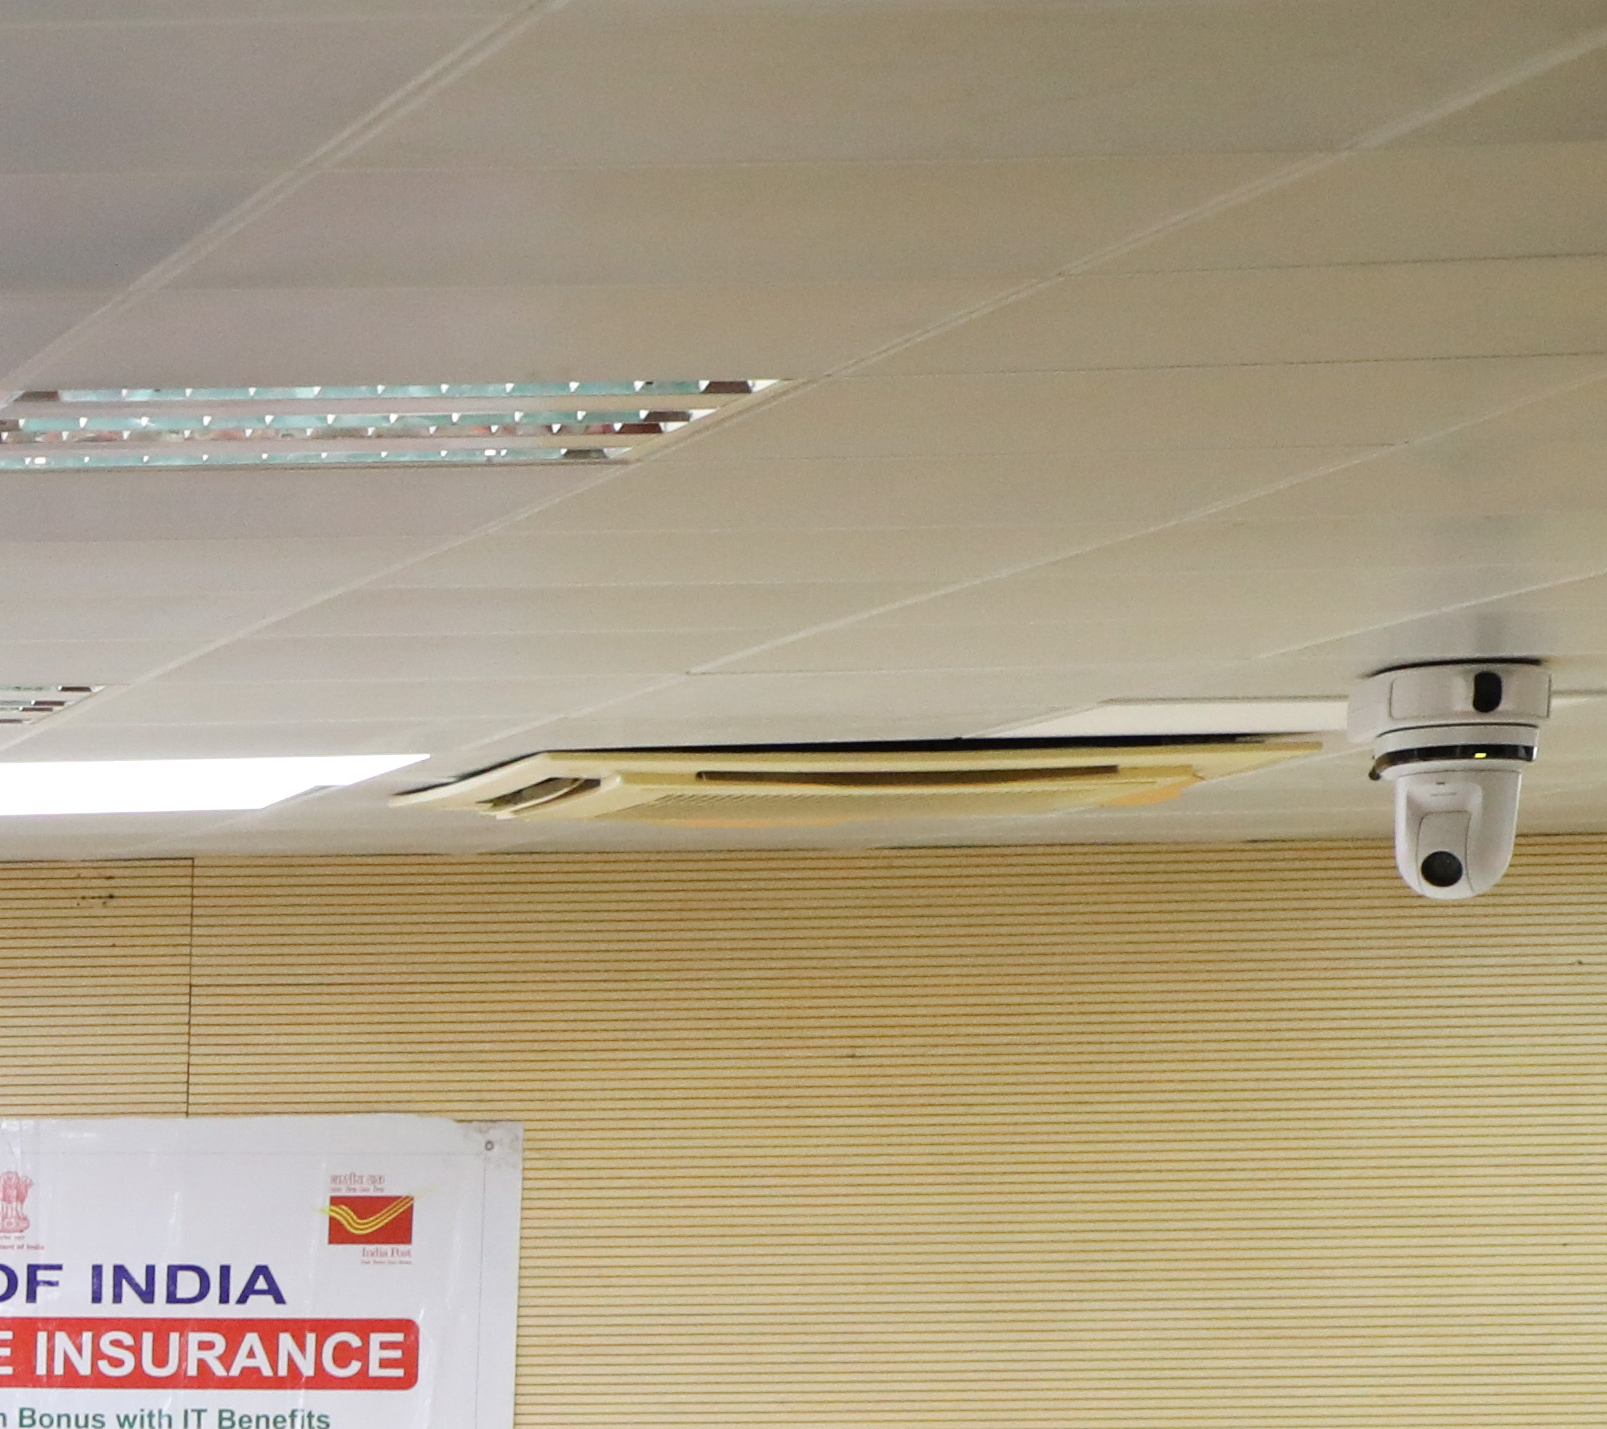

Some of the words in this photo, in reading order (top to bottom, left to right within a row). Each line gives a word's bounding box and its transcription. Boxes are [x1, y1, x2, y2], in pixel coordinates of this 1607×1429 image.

[362, 1247, 388, 1257] India
[91, 1264, 287, 1305] INDIA
[35, 1330, 405, 1378] INSURANCE
[19, 1407, 106, 1429] Bonus
[117, 1408, 173, 1429] with
[183, 1408, 208, 1429] IT
[218, 1408, 331, 1429] Benefits
